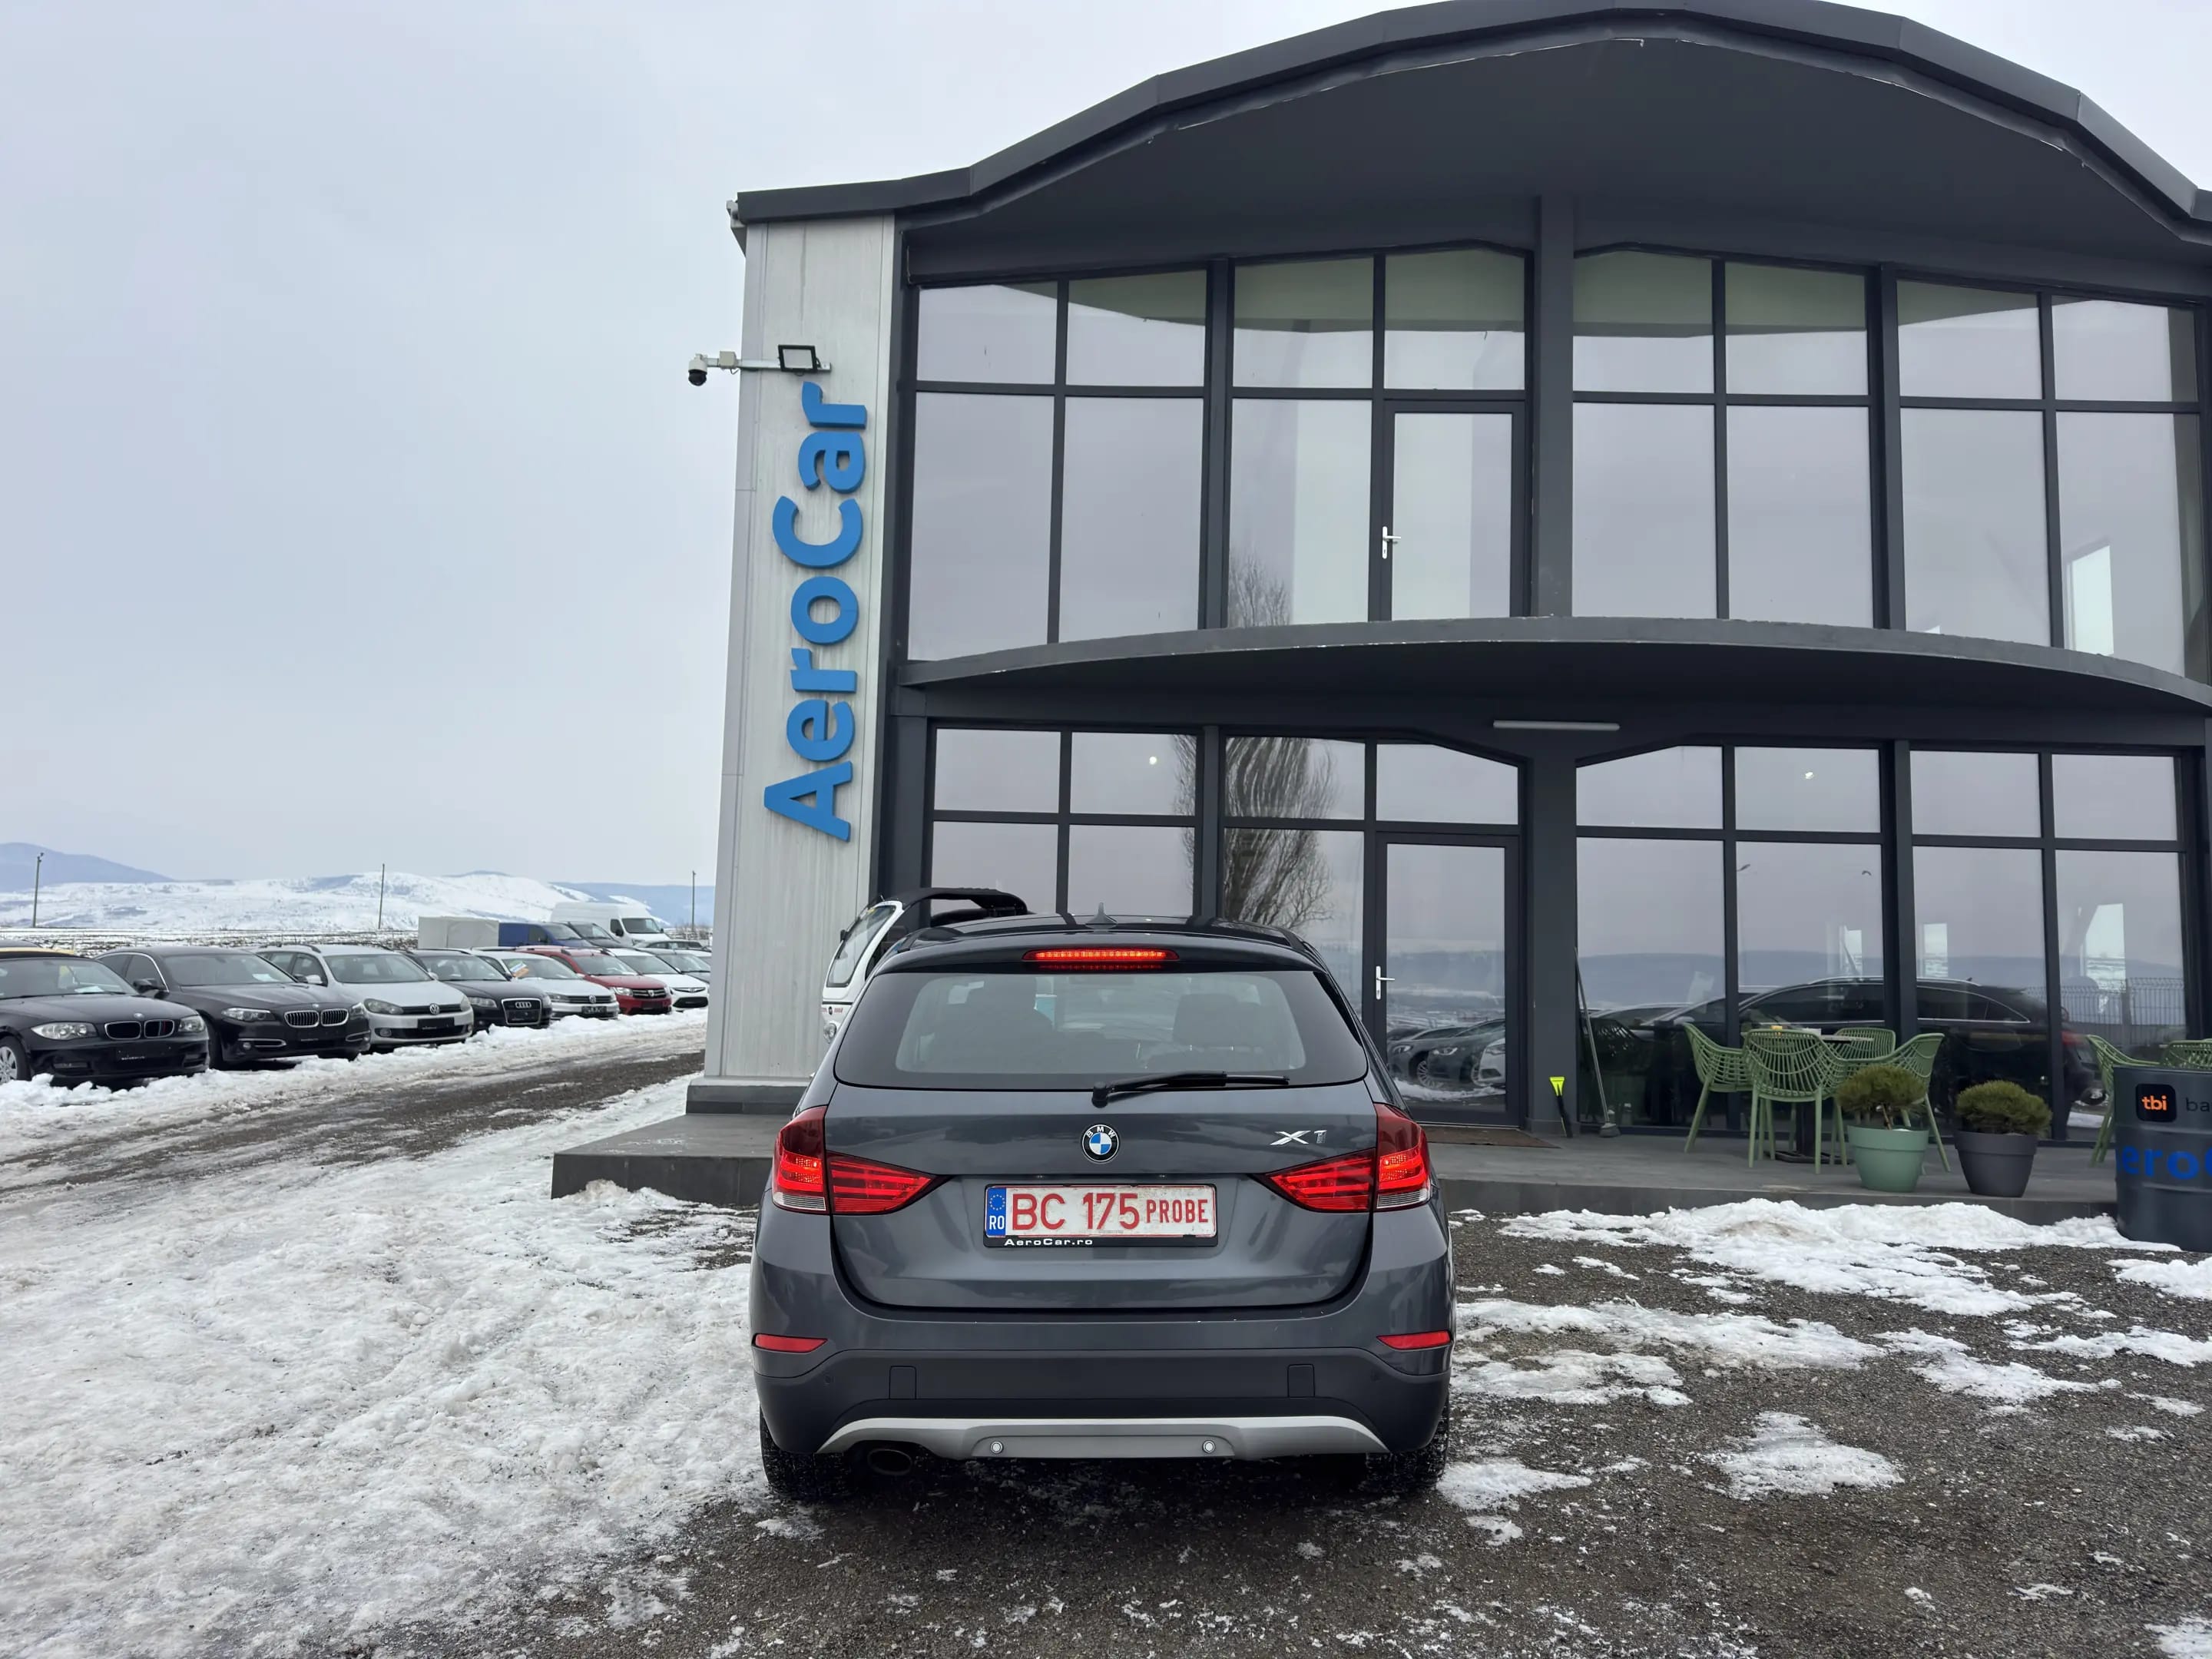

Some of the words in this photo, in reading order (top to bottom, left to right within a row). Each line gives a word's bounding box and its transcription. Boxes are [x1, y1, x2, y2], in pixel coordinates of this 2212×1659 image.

[763, 381, 868, 843] AeroCar
[2141, 1094, 2167, 1111] tbi
[2185, 1097, 2212, 1113] ba
[1085, 1125, 1117, 1138] BMW
[1269, 1130, 1327, 1145] X1
[2117, 1145, 2212, 1181] ero
[1012, 1193, 1066, 1230] BC
[1082, 1192, 1140, 1230] 175
[1146, 1199, 1209, 1224] PROBE
[988, 1215, 1005, 1230] RO
